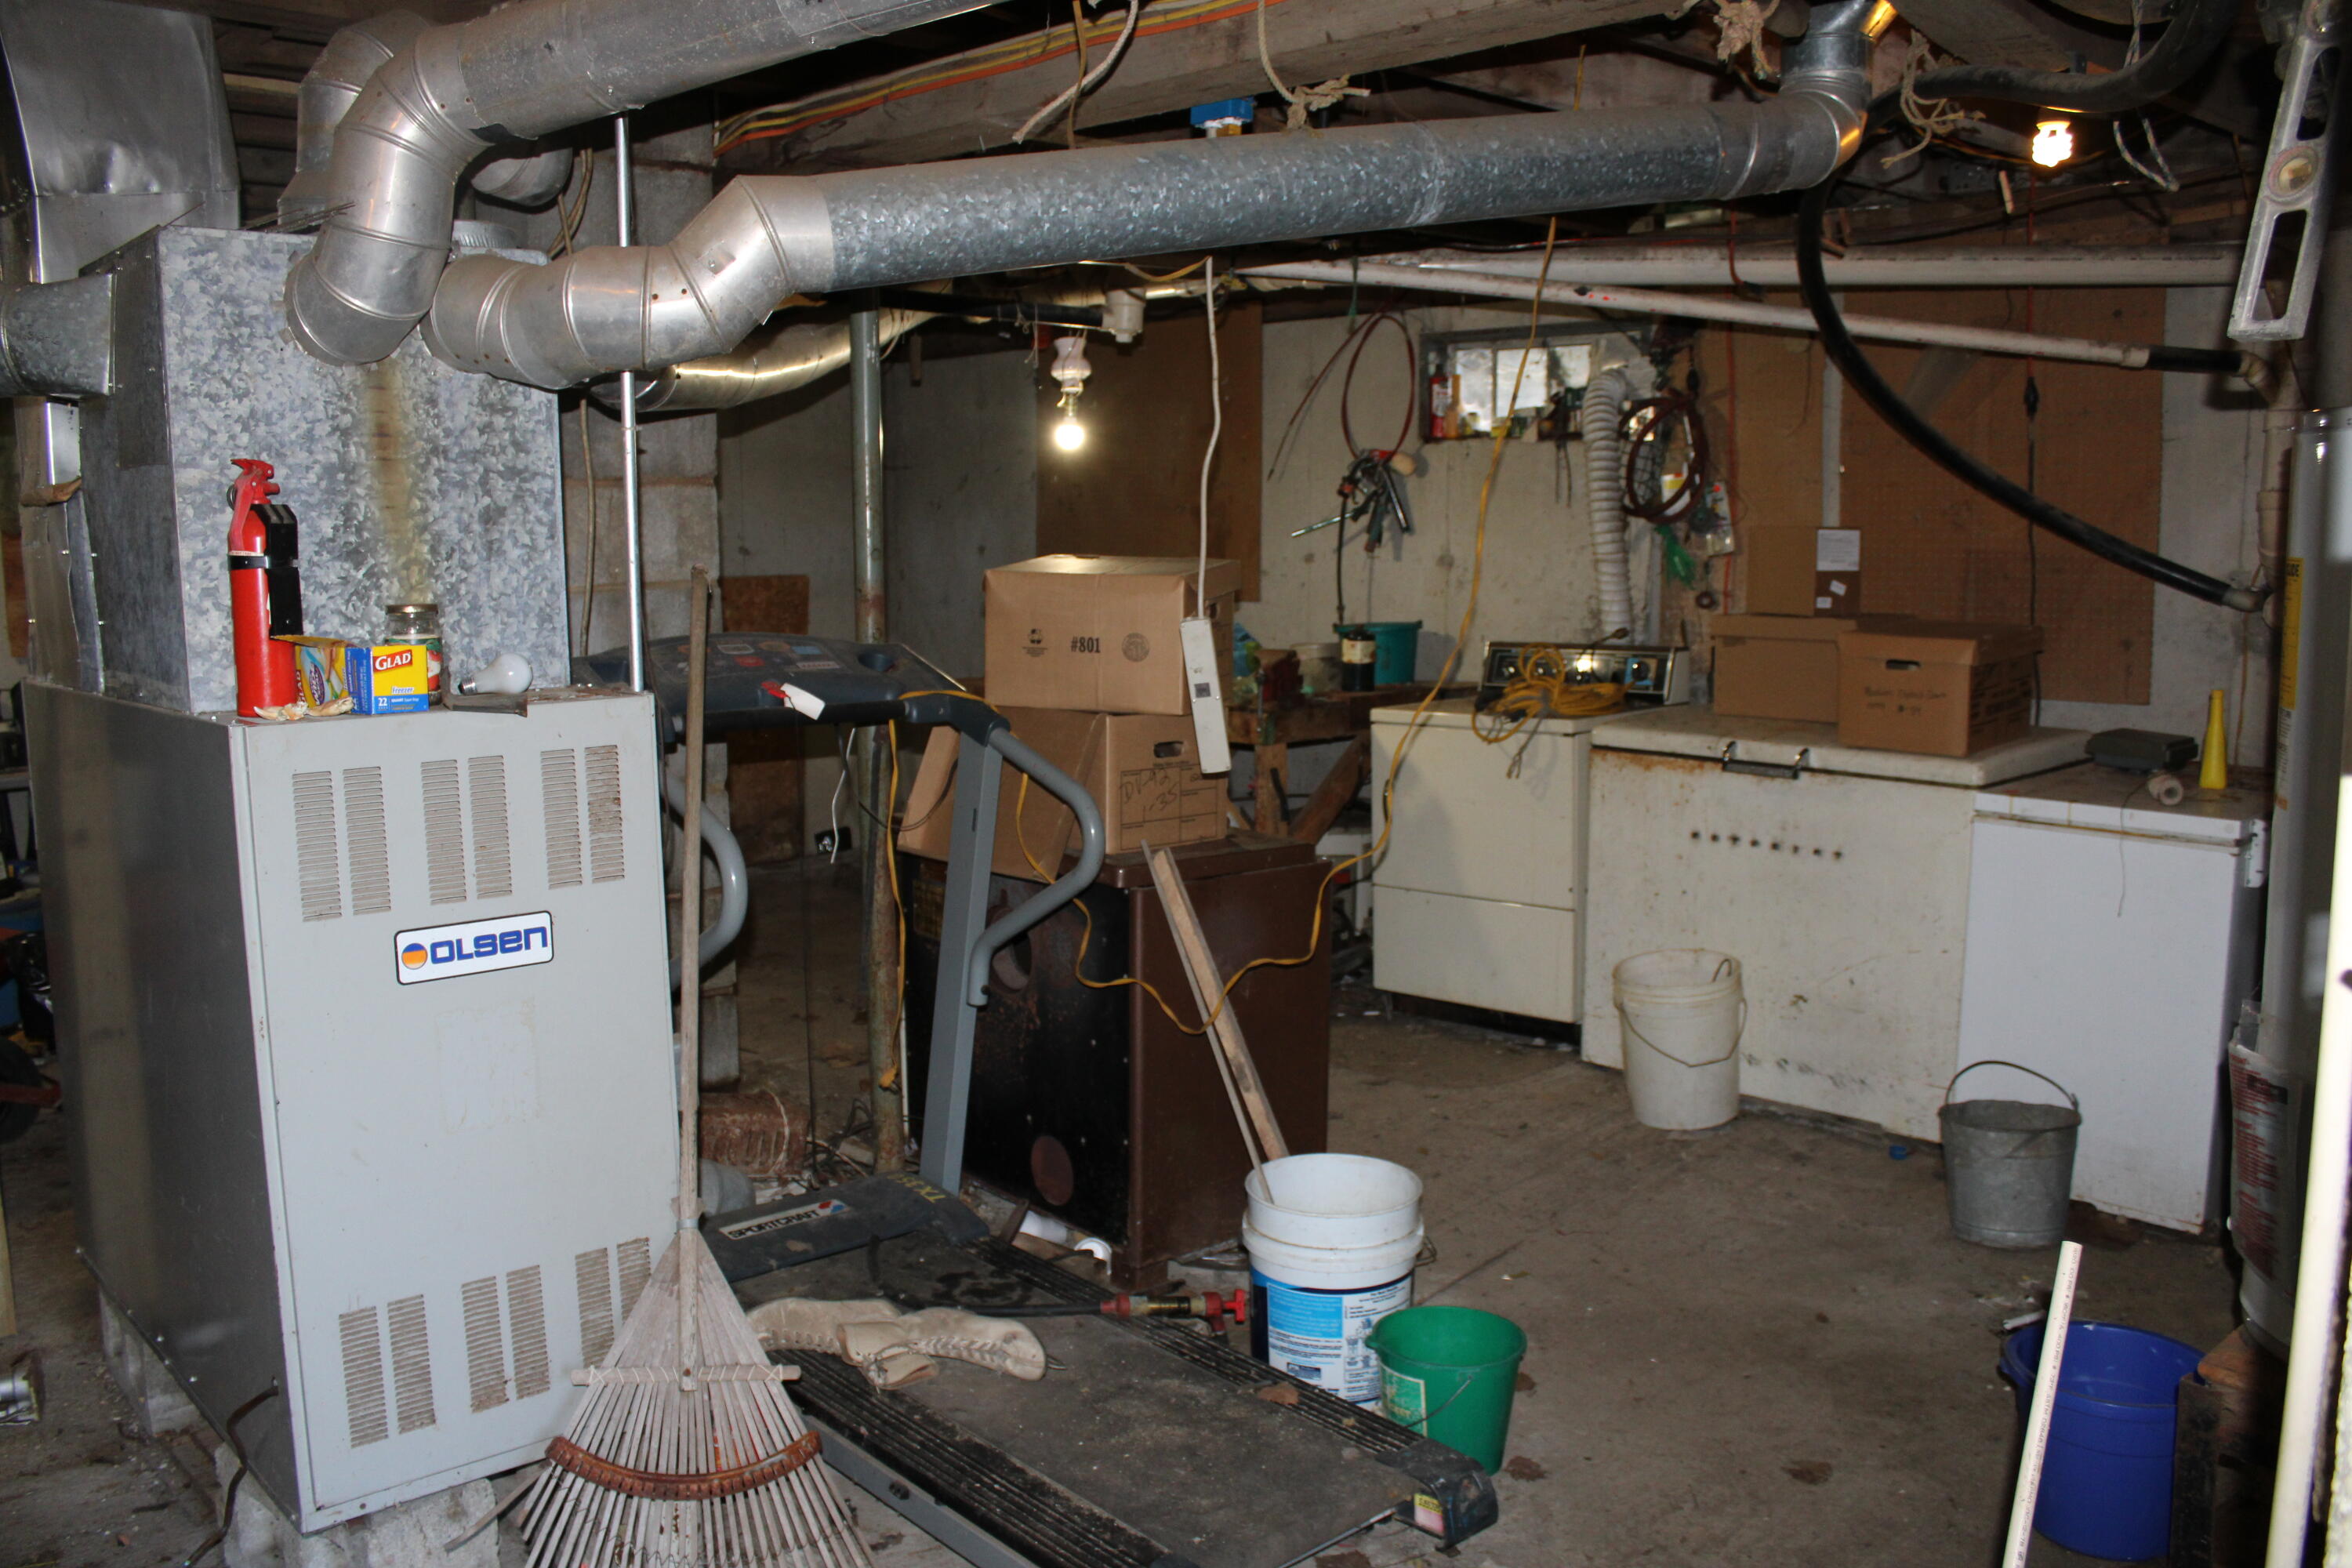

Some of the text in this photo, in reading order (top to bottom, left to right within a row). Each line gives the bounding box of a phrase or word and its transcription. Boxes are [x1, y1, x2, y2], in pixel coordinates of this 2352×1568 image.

[1071, 636, 1101, 653] #801
[375, 652, 412, 671] GLAD
[378, 697, 387, 706] 22
[728, 1209, 820, 1238] SPORTCRAFT
